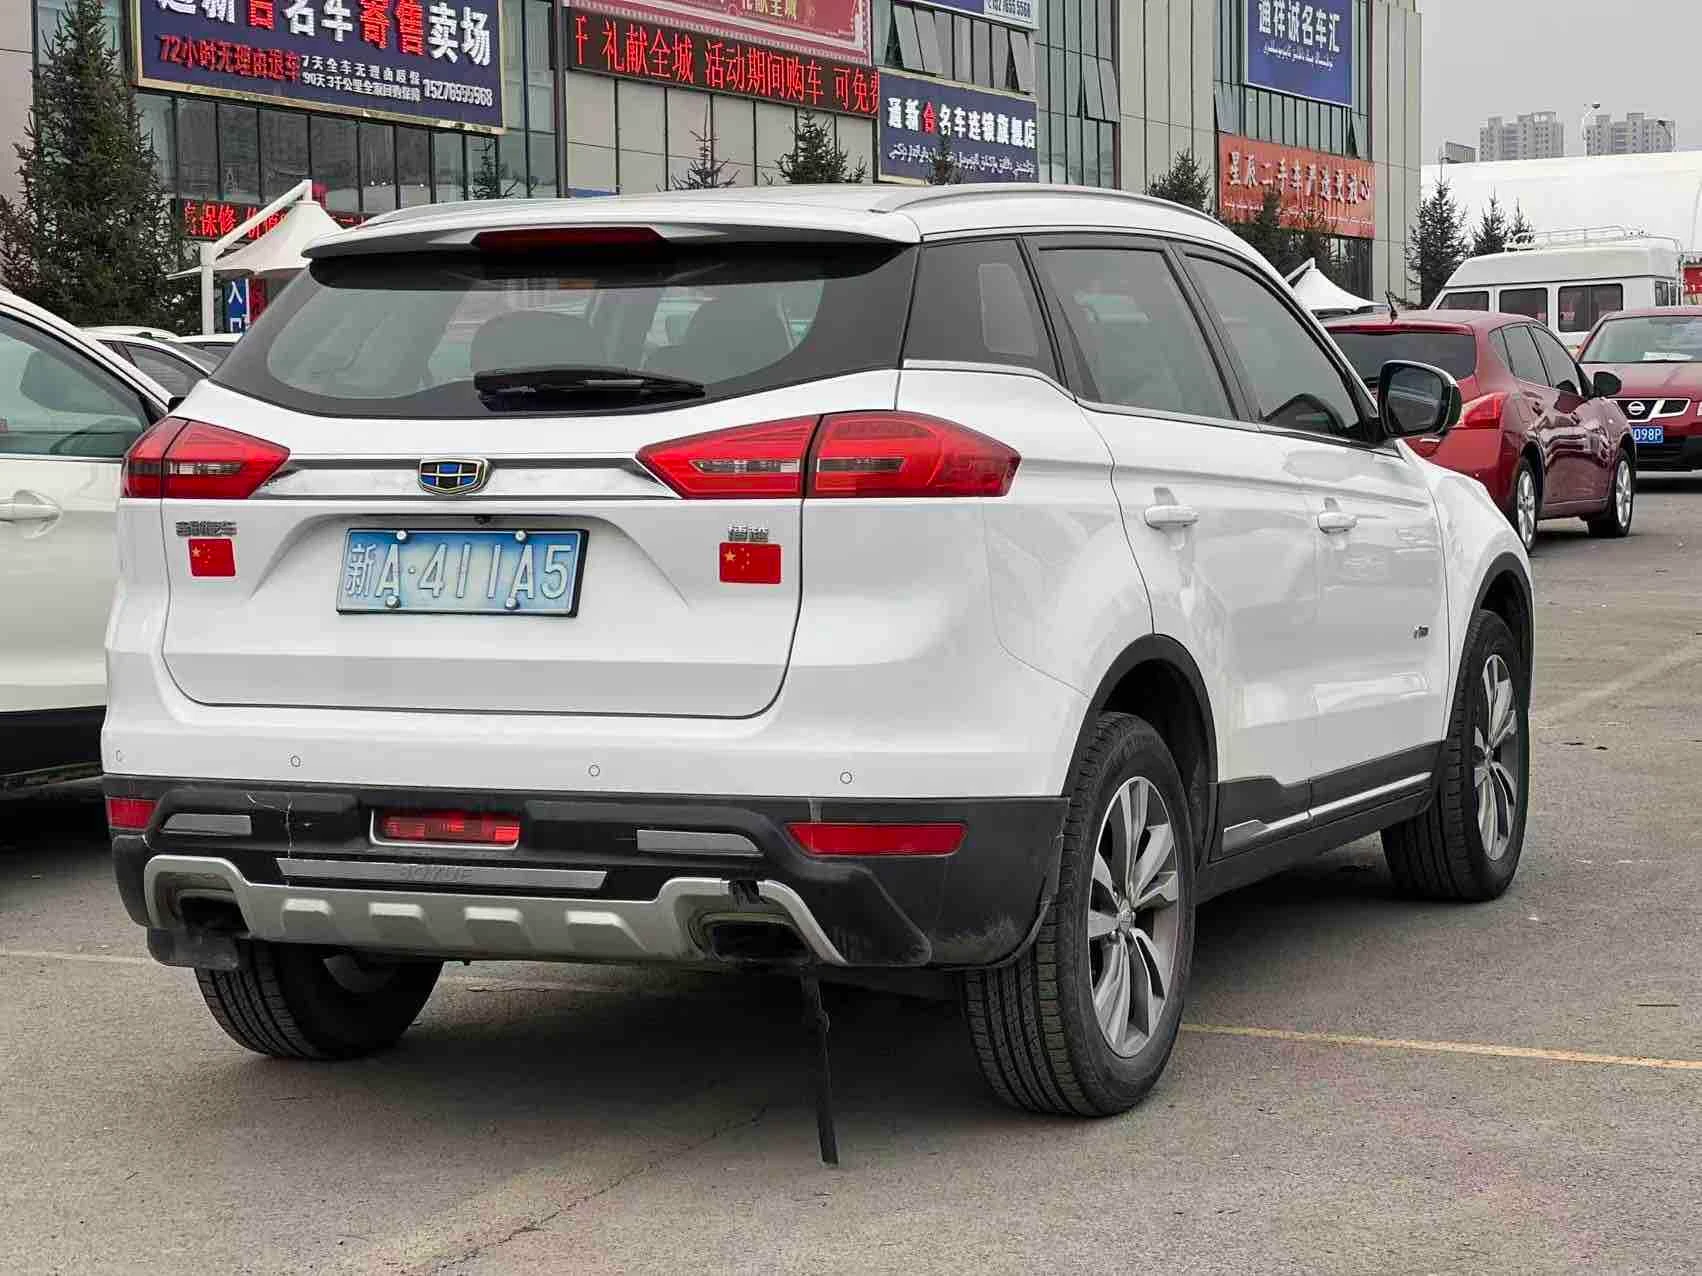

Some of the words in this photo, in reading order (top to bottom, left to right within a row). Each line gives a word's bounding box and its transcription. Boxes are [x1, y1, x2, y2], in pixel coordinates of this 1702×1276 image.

[601, 18, 694, 84] 礼献全城
[704, 40, 824, 105] 活动期间购车
[1632, 428, 1661, 441] 098P
